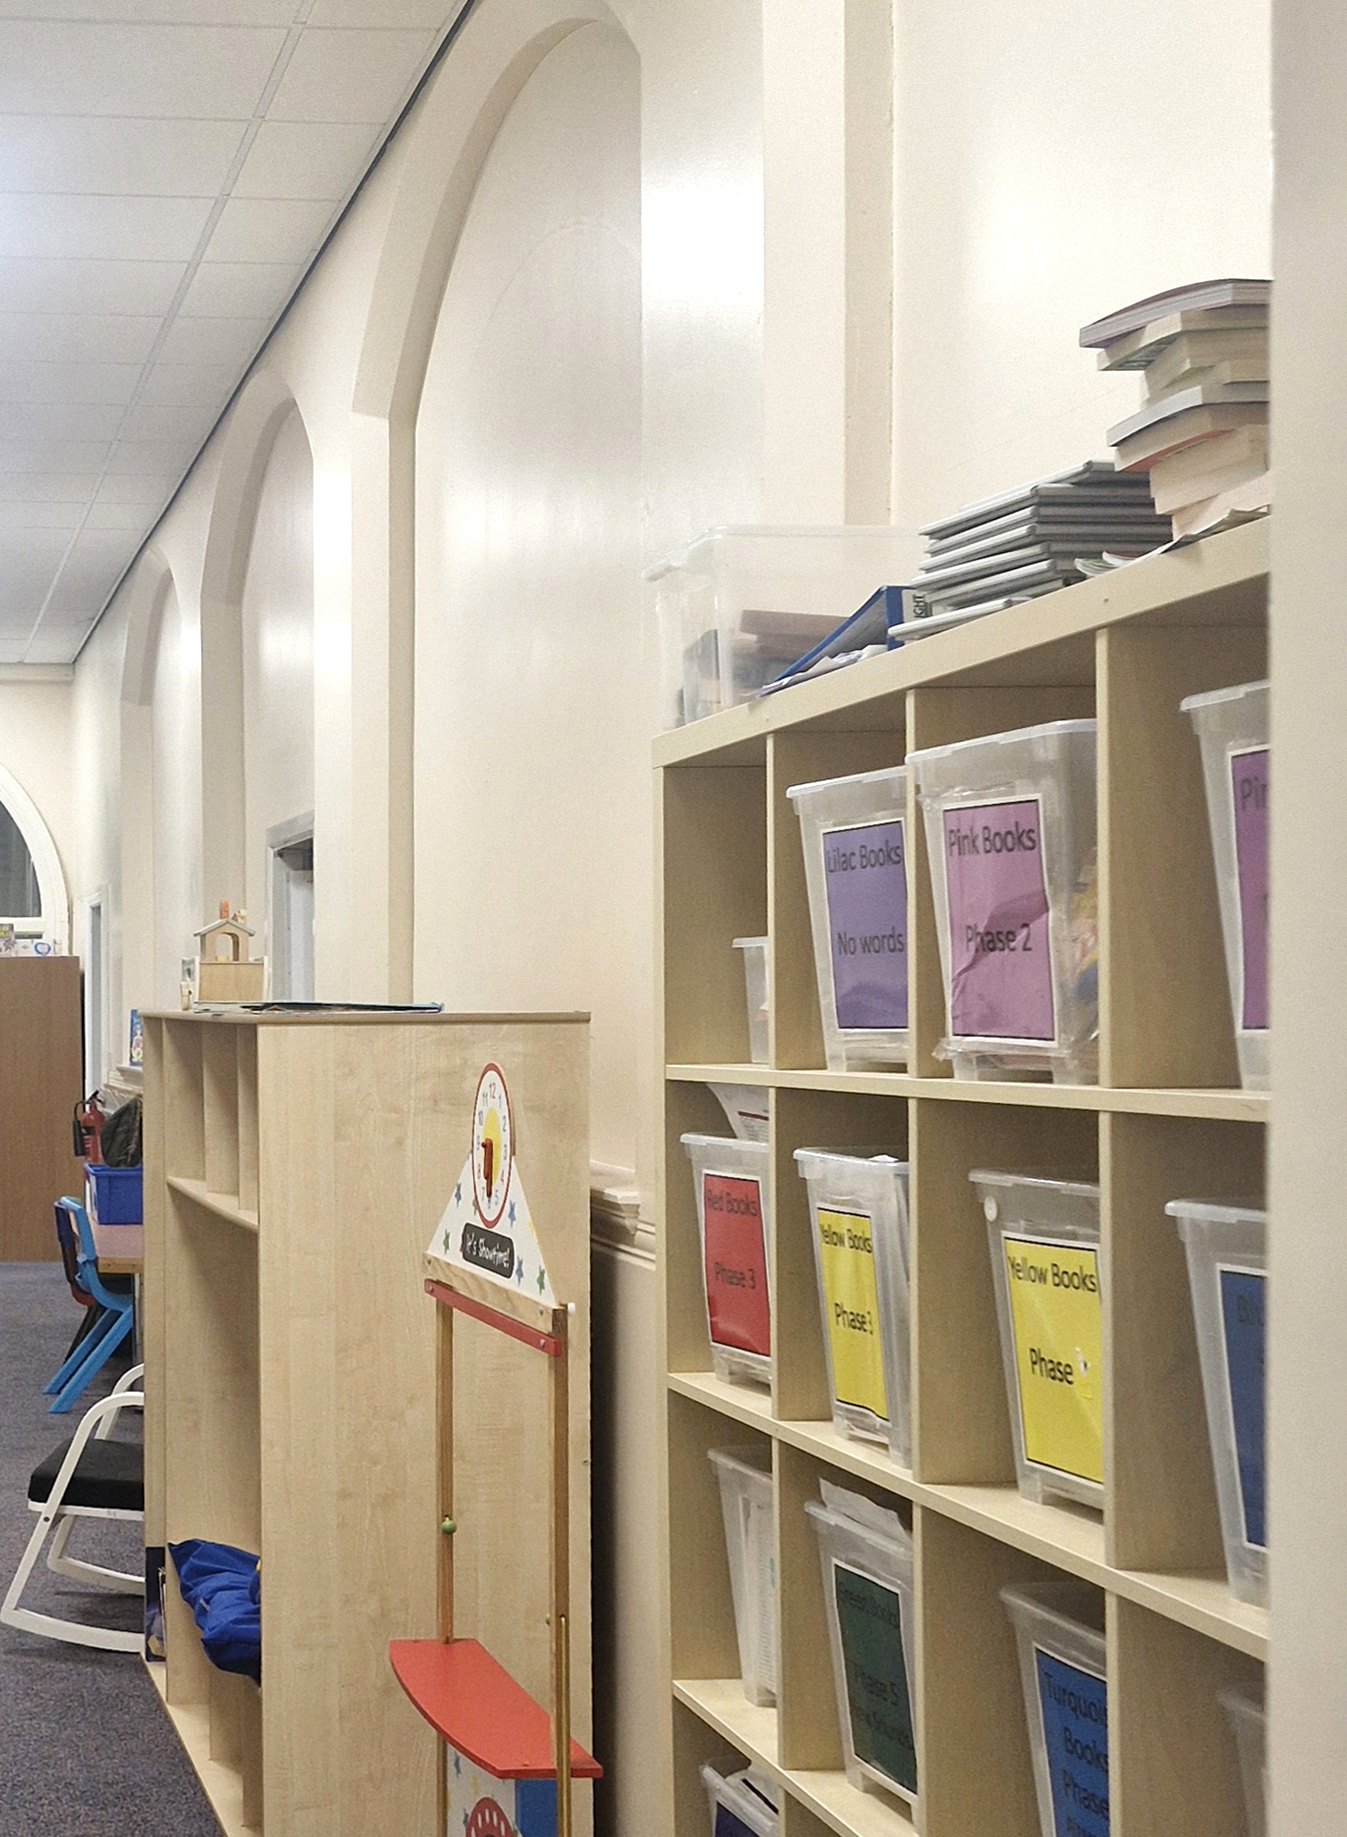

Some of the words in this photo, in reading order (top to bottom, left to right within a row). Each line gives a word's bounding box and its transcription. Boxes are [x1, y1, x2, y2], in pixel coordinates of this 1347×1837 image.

[949, 827, 979, 856] Pink
[983, 821, 1037, 853] Books
[826, 847, 856, 873] Lilac
[860, 840, 903, 868] Books
[837, 932, 856, 956] No
[861, 926, 905, 953] words
[966, 924, 1016, 953] Phase
[1021, 923, 1032, 951] 2
[482, 1091, 488, 1107] 11
[489, 1082, 496, 1099] 12
[478, 1110, 484, 1126] 10
[502, 1115, 507, 1132] 2
[707, 1189, 725, 1212] Red
[726, 1192, 759, 1217] Books
[465, 1232, 477, 1256] It's
[819, 1223, 845, 1248] Yellow
[846, 1228, 873, 1253] Books
[714, 1261, 746, 1288] Phase
[748, 1267, 757, 1290] 3
[1008, 1255, 1047, 1285] Yellow
[1051, 1263, 1097, 1293] Books
[834, 1302, 867, 1332] Phase
[1029, 1348, 1074, 1385] Phase
